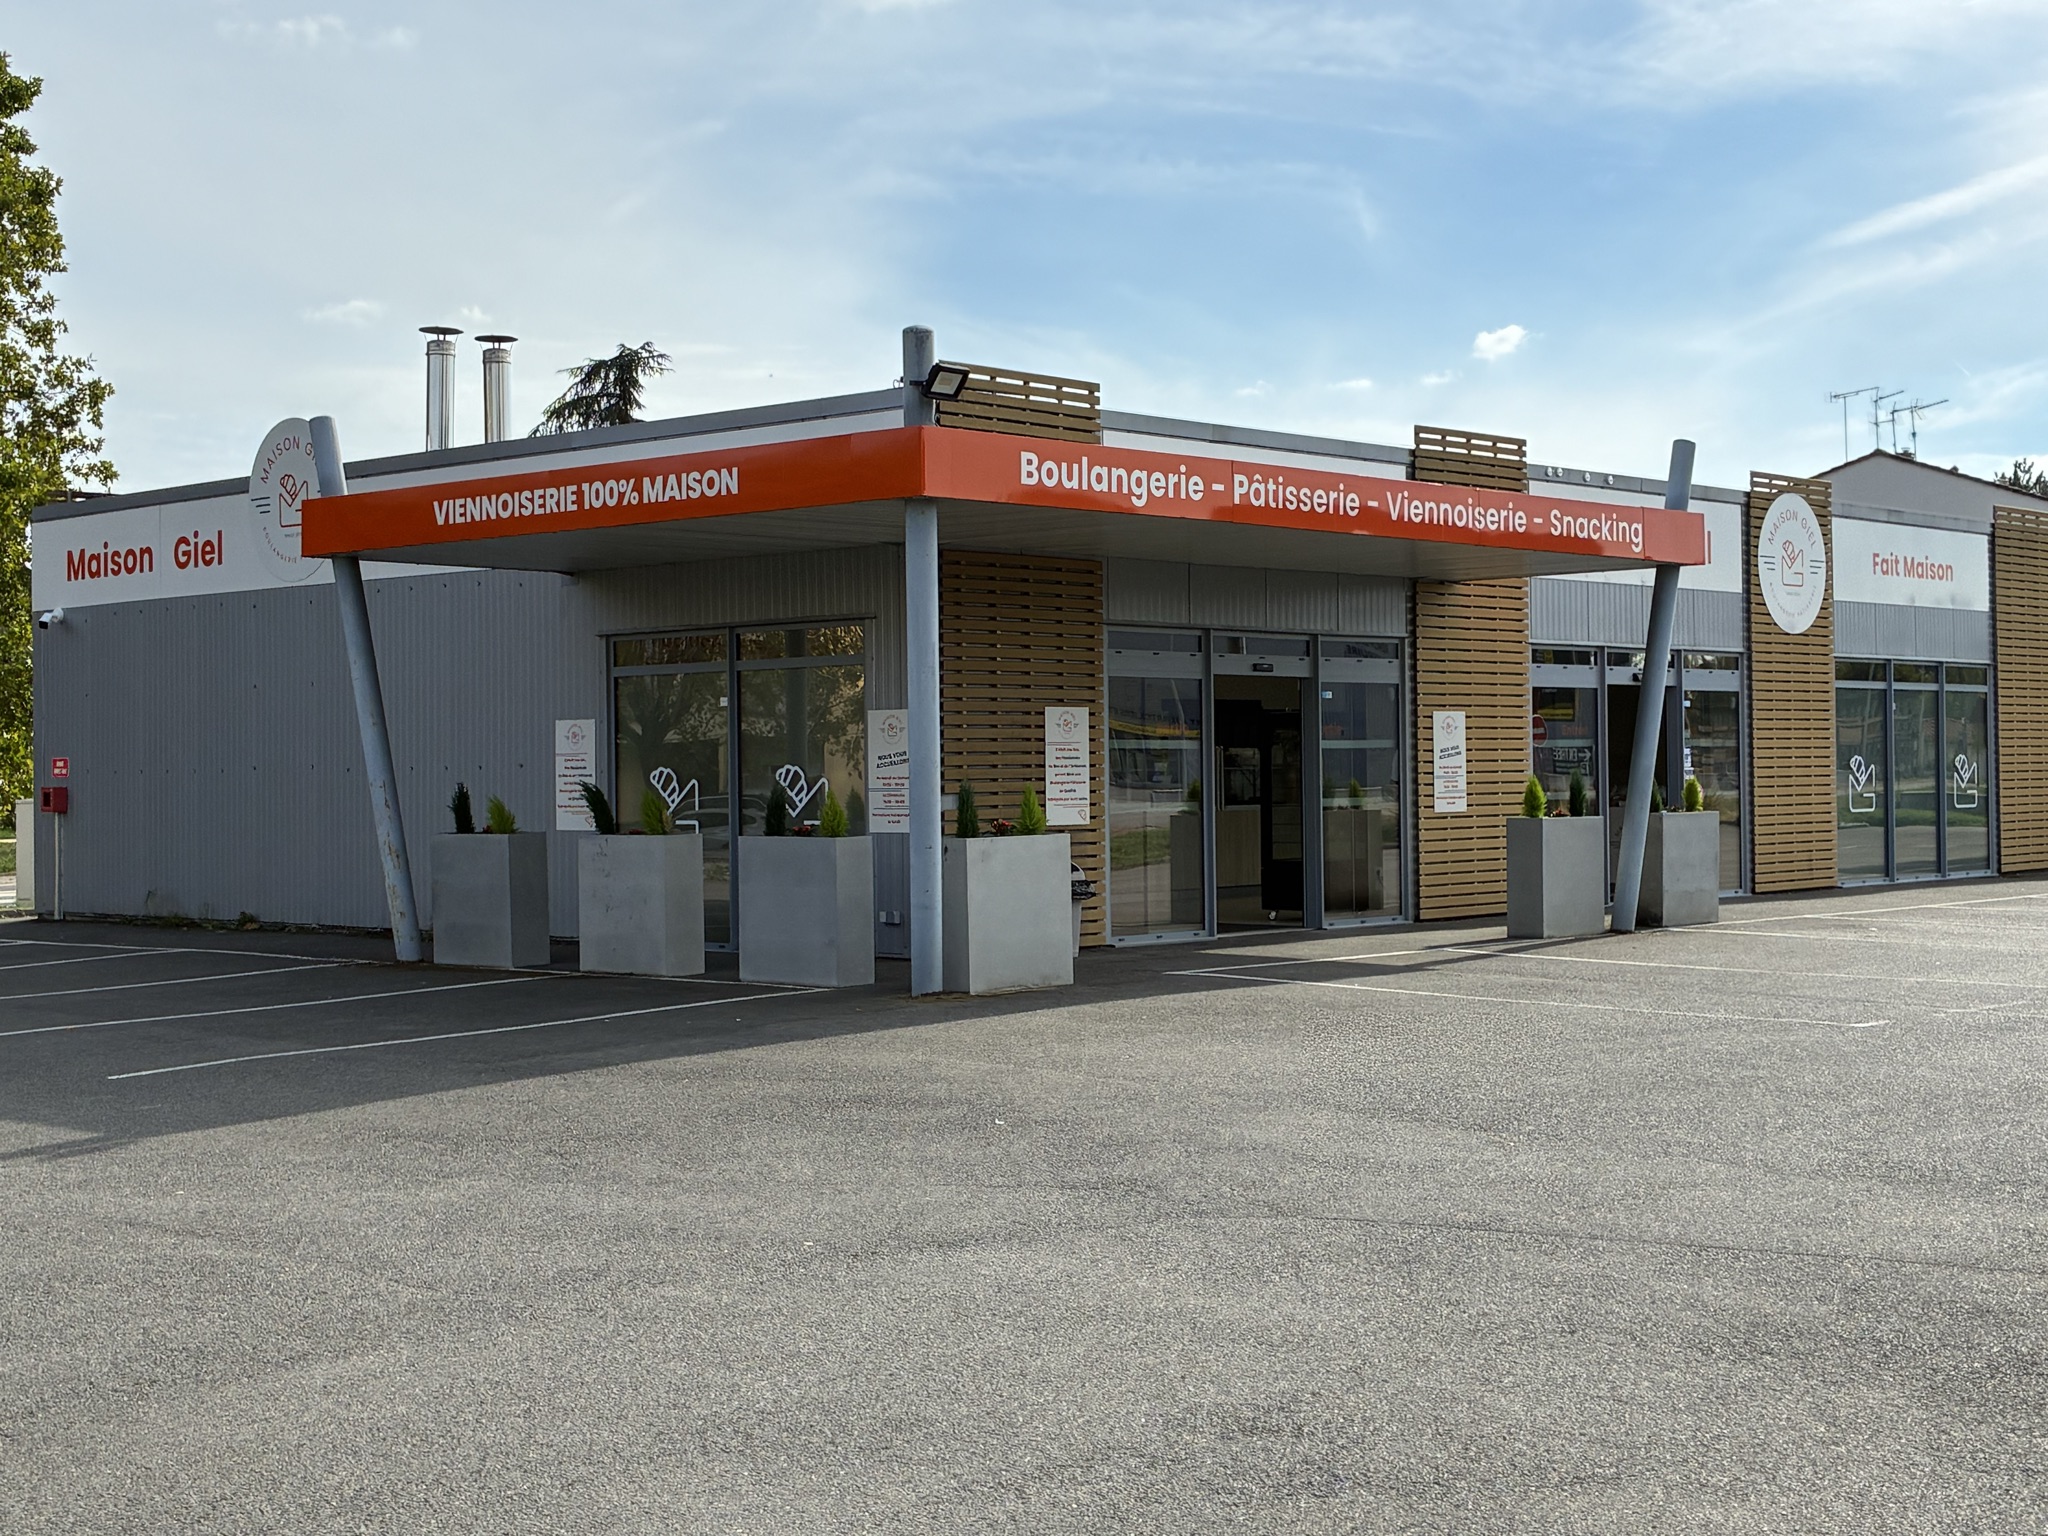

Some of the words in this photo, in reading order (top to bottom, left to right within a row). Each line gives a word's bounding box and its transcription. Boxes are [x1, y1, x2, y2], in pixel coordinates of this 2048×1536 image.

[260, 435, 300, 484] MAISON
[433, 485, 578, 526] VIENNOISERIE
[582, 478, 639, 510] 100%
[642, 467, 739, 504] MAISON
[1020, 451, 1204, 507] Boulangerie
[1234, 473, 1360, 517] Pâtisserie
[1386, 491, 1527, 533] Viennoiserie
[1550, 509, 1643, 553] Snacking
[1768, 509, 1799, 546] MAISON
[67, 541, 154, 581] Maison
[173, 530, 223, 570] Giel
[1872, 552, 1900, 577] Fait
[1903, 555, 1953, 582] Maison
